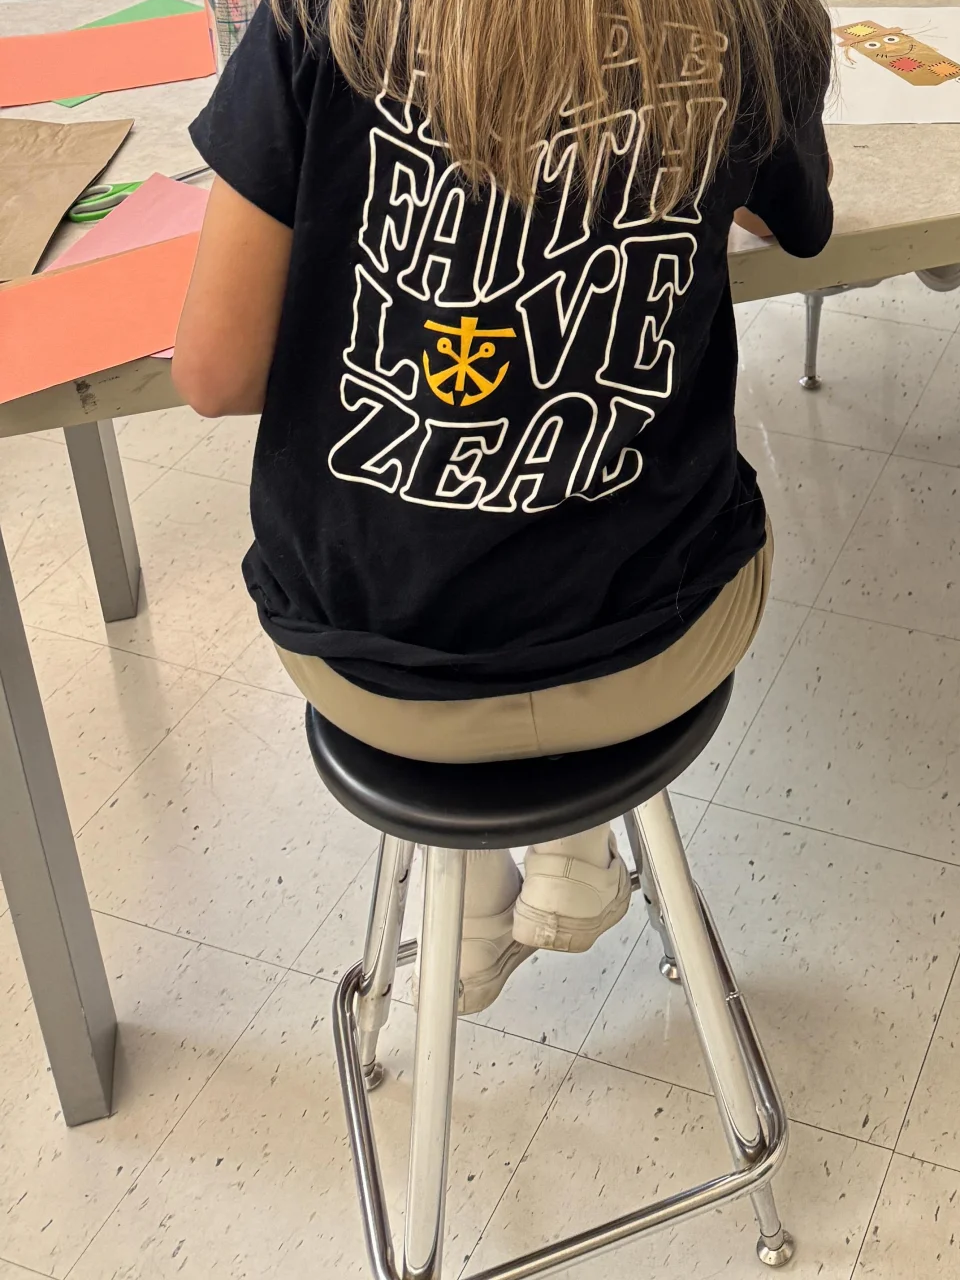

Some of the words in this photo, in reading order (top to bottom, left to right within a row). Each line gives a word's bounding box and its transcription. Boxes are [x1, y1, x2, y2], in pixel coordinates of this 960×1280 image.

[358, 96, 728, 308] FAITH
[343, 231, 698, 400] LVE
[328, 373, 655, 513] ZEAL
